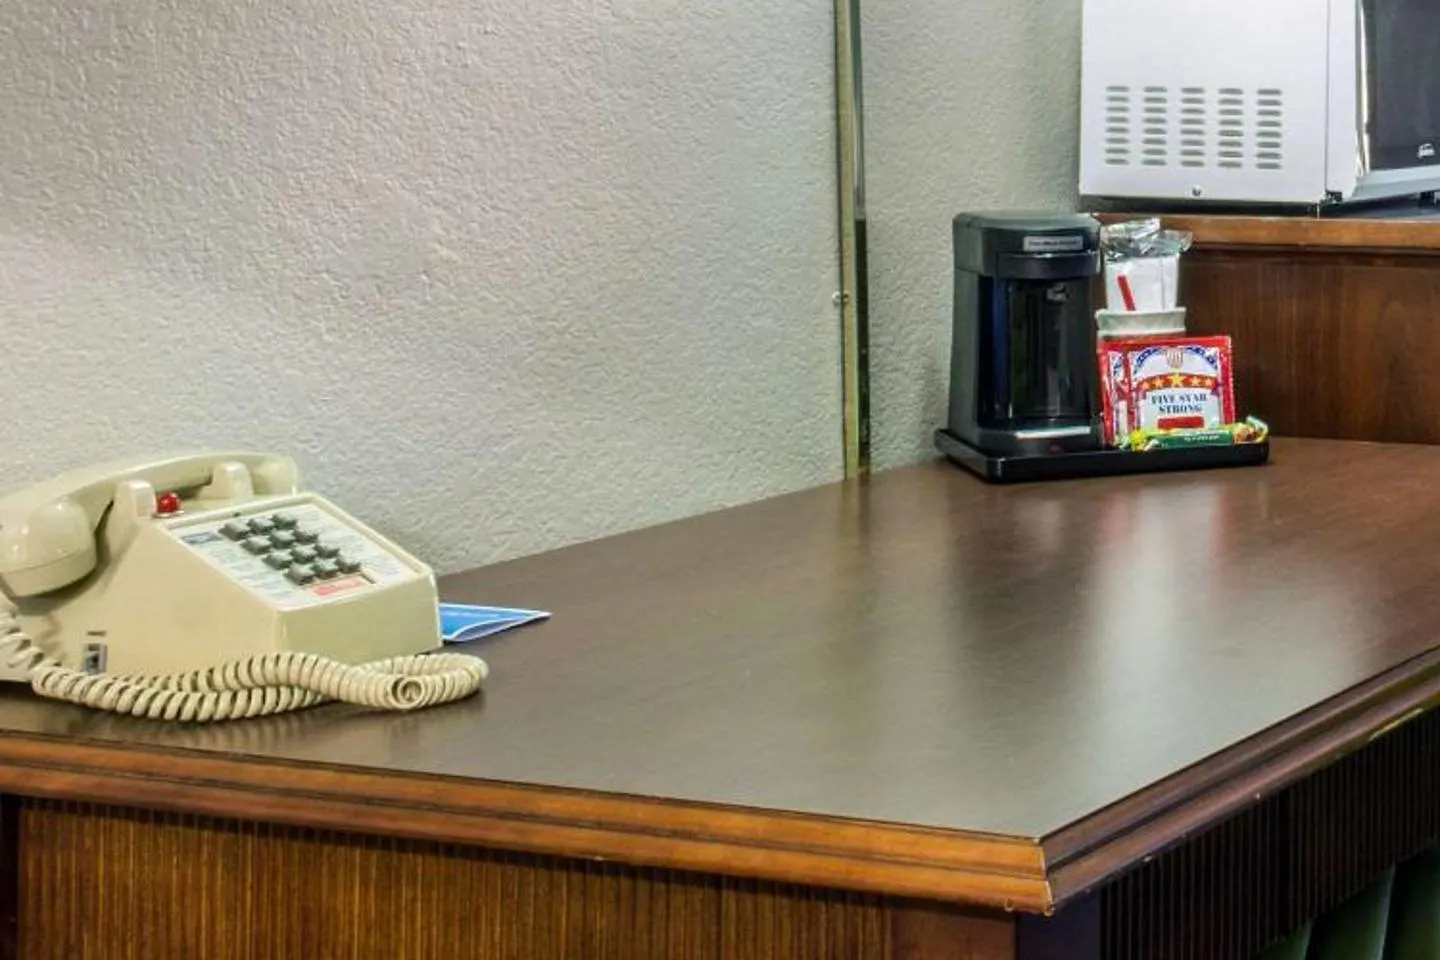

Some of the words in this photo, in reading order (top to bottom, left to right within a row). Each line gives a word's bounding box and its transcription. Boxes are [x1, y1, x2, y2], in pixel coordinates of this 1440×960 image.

[1151, 394, 1175, 404] FIVE
[1179, 393, 1207, 402] STAR
[1159, 404, 1202, 413] STRONG
